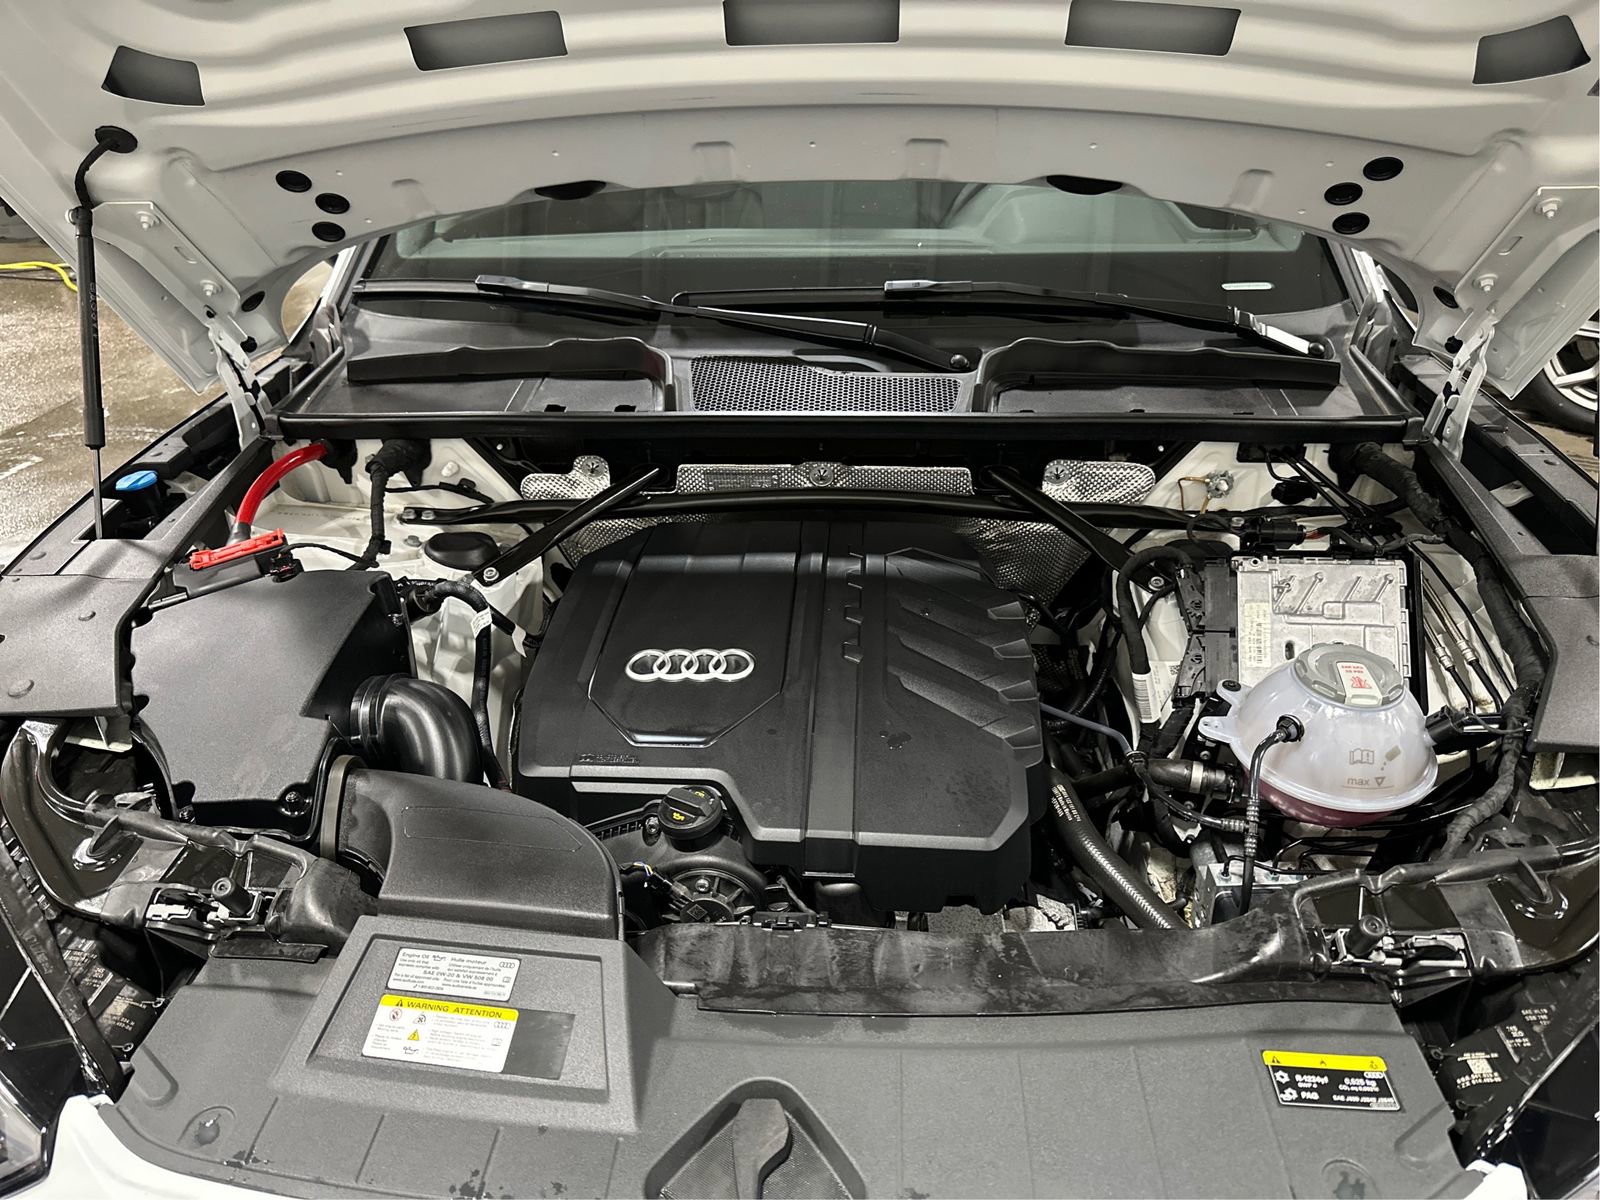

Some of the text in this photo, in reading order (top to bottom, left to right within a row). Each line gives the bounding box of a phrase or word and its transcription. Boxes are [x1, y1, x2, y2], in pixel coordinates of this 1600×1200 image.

[1347, 776, 1370, 786] max
[406, 1001, 502, 1018] WARNING ATTENTION
[1366, 1079, 1377, 1087] kg
[1301, 1092, 1320, 1100] PAG
